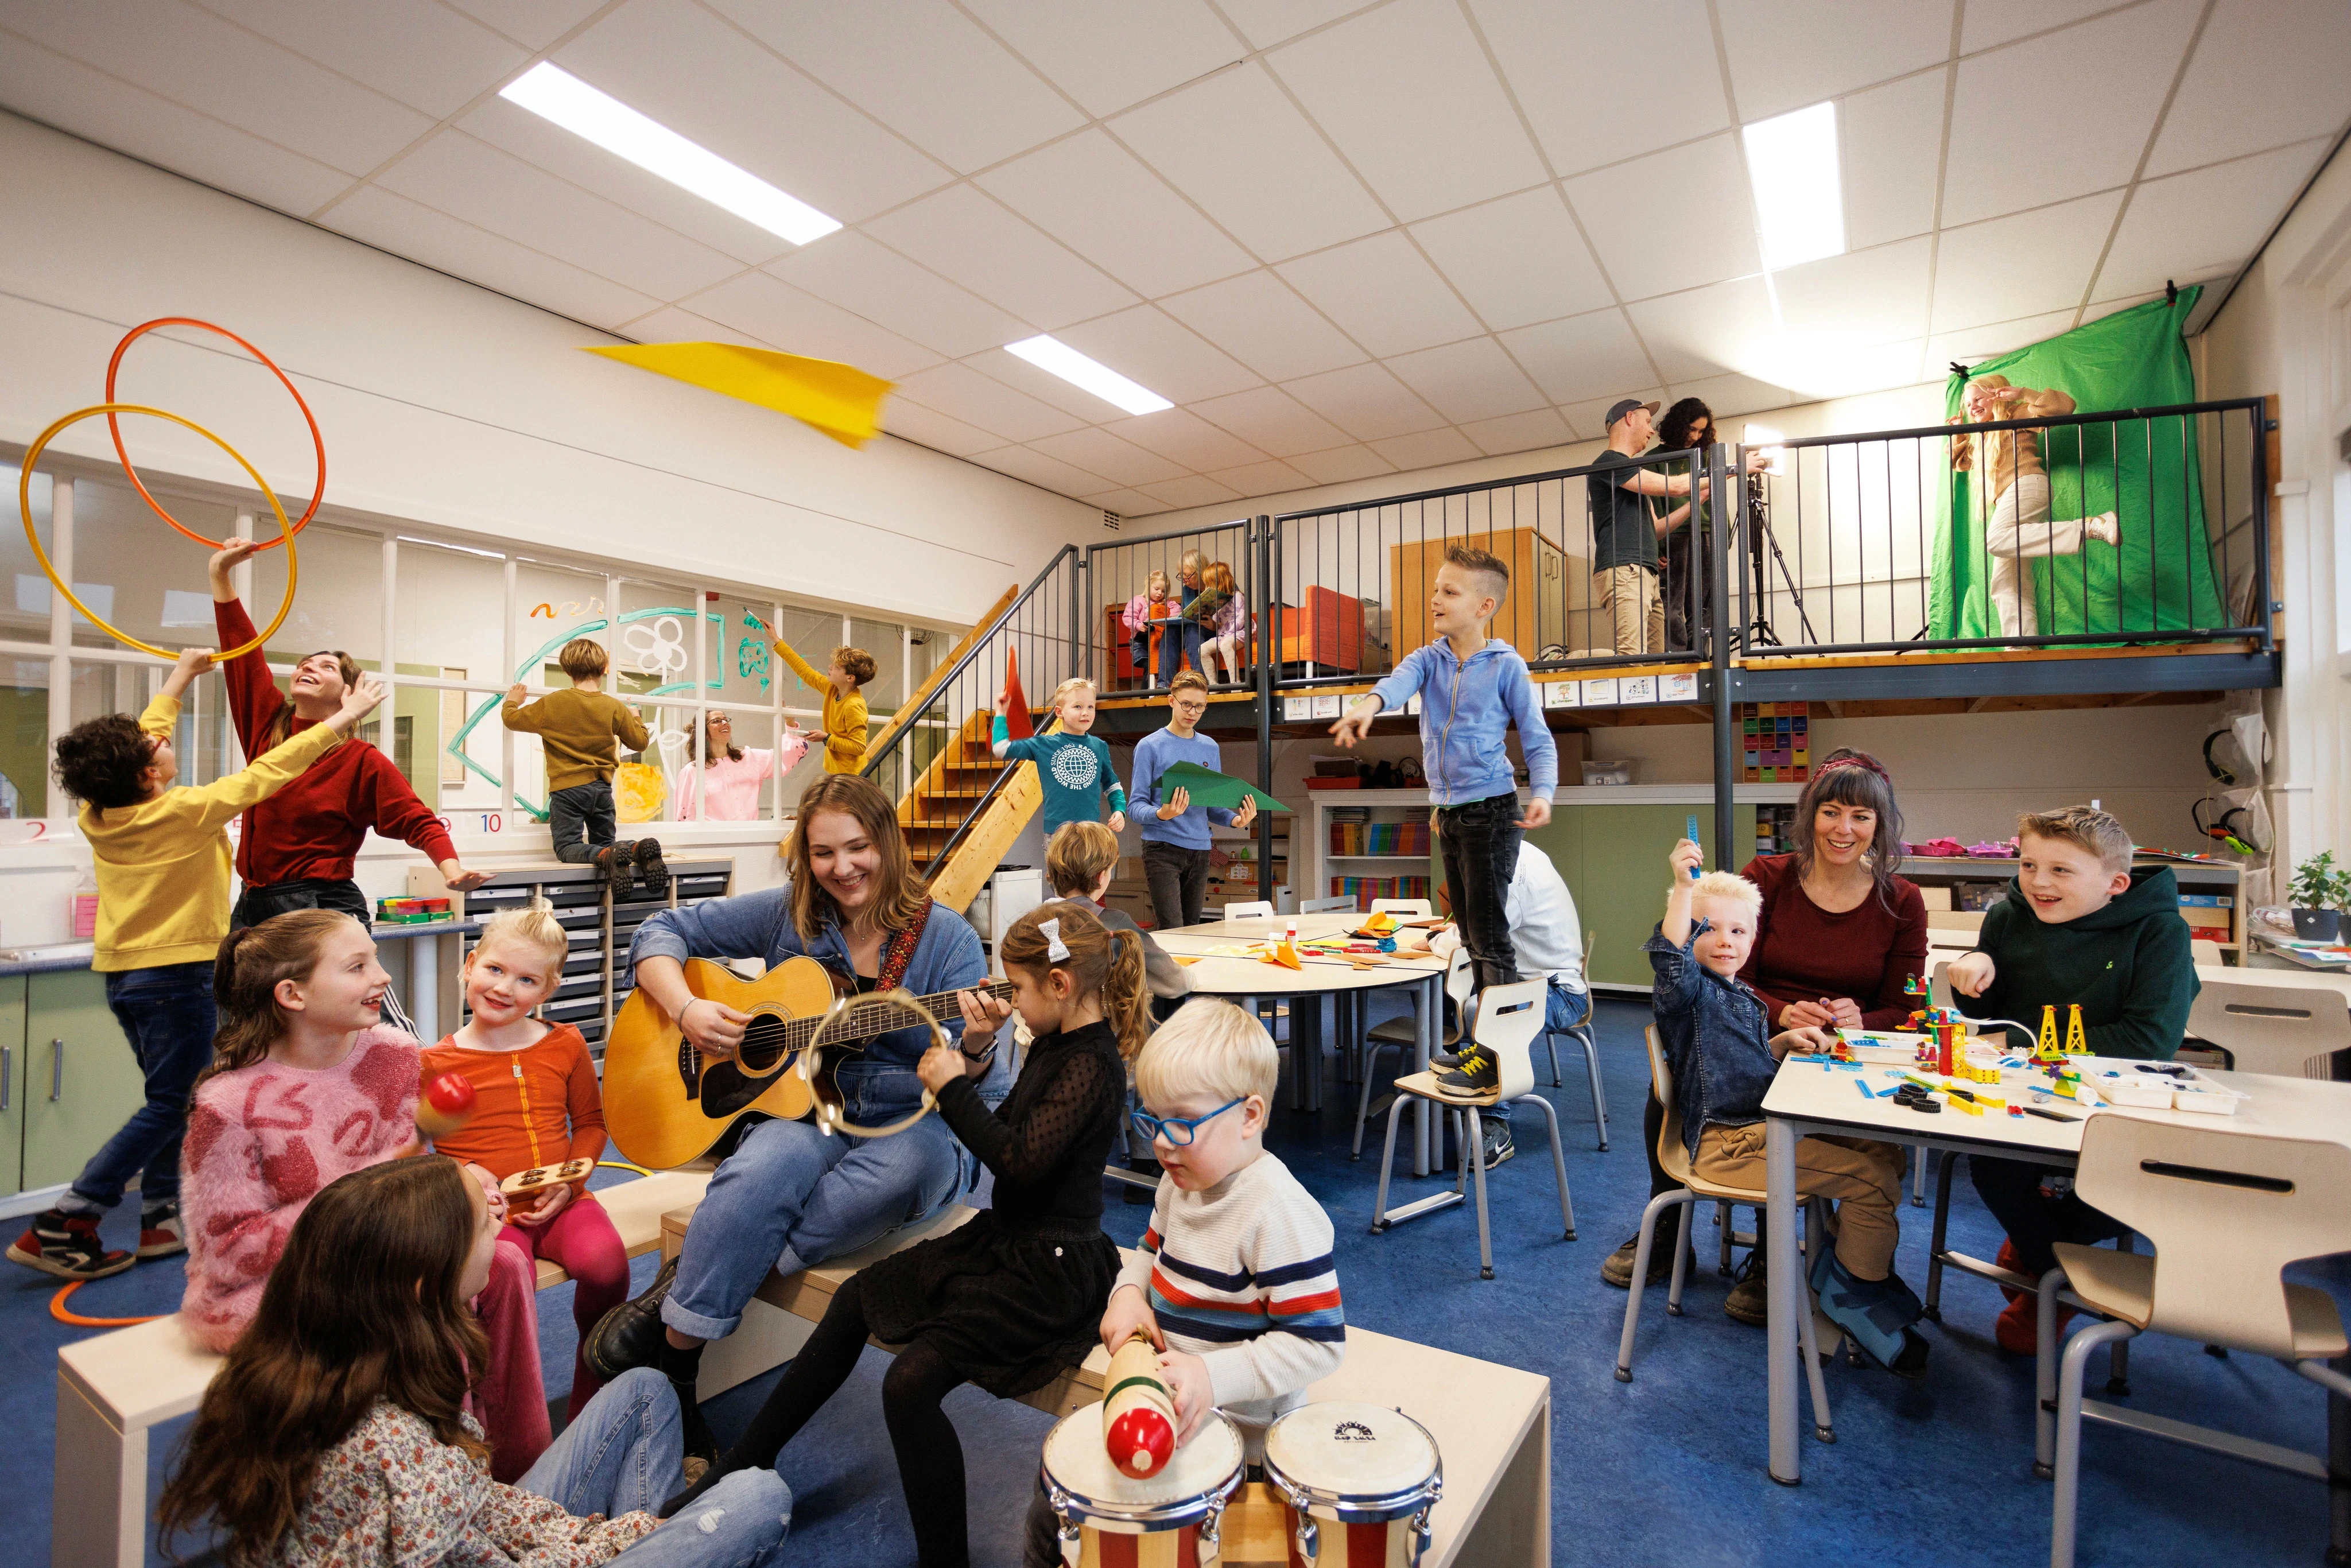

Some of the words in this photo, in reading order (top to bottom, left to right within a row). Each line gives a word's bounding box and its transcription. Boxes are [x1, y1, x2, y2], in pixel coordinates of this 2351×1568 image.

[1051, 749, 1062, 766] SINCE
[1078, 744, 1097, 763] RACING
[1051, 767, 1068, 787] WORLD
[1083, 765, 1097, 788] AROUND
[26, 821, 50, 841] 2
[439, 817, 452, 832] 9
[481, 814, 501, 832] 10
